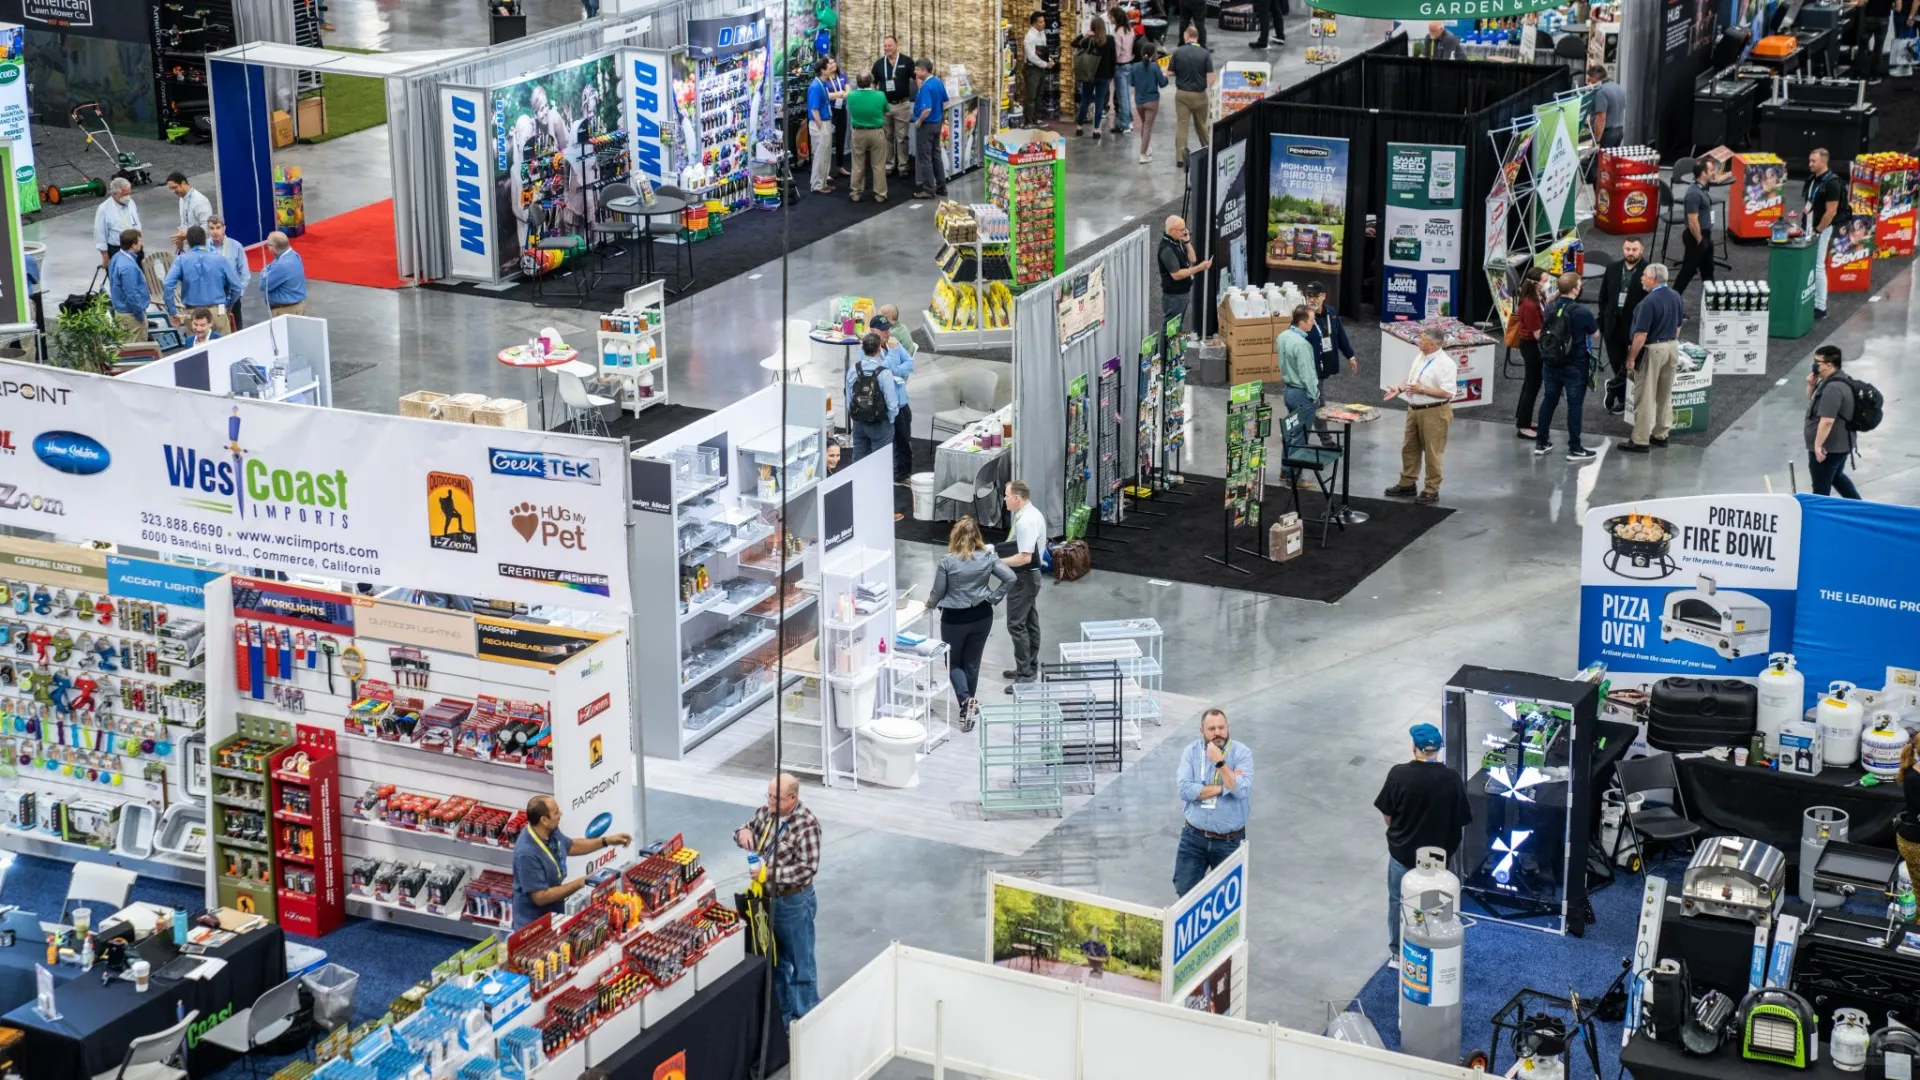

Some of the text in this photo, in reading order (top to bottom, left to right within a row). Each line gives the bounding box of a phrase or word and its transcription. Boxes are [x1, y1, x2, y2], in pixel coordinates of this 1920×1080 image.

[30, 6, 86, 20] Lawn Mower Co.
[1420, 2, 1504, 15] GARDEN
[1513, 0, 1523, 10] &
[10, 122, 18, 130] THE
[12, 115, 26, 123] ENJOY
[4, 128, 24, 136] PERFECT
[496, 100, 508, 170] DRAMM
[1289, 148, 1328, 156] PENNINGTON
[1393, 156, 1426, 164] SMART
[1281, 162, 1336, 174] HIGH-QUALITY
[1392, 162, 1426, 170] SEED
[452, 96, 486, 256] DRAMM
[1284, 170, 1332, 182] BIRD SEED
[1425, 228, 1454, 236] PATCH
[1388, 278, 1416, 286] LAWN
[1388, 286, 1417, 294] BOOSTER
[0, 380, 72, 405] POINT
[1672, 397, 1706, 406] ARANTEED.
[44, 441, 68, 454] Home
[246, 458, 348, 510] Coast
[430, 474, 470, 494] OUTDOORSMAN
[632, 500, 671, 510] esign Ideas
[254, 504, 349, 530] IMPORTS
[542, 505, 586, 524] HUG My
[1709, 506, 1778, 534] PORTABLE
[140, 512, 379, 560] 323.888.6690 www.wciimports.com
[463, 534, 472, 542] by
[542, 521, 587, 550] Pet
[1683, 526, 1776, 560] FIRE BOWL
[142, 530, 381, 576] 6000 Bandini Blvd., Commerce, California
[14, 556, 84, 574] CAMPING LIGHTS
[500, 565, 556, 580] CREATIVE
[1749, 565, 1774, 573] campfire
[120, 575, 205, 594] ACCENT LIGHTIN
[262, 598, 325, 616] WORKLIGHTS
[1602, 593, 1650, 622] PIZZA
[1820, 589, 1842, 602] THE
[1845, 591, 1897, 609] LEADING
[368, 618, 462, 639] OUTDOOR LIGHTING
[478, 623, 518, 636] FARPOINT
[1601, 619, 1645, 649] OVEN
[482, 638, 554, 653] RECHARGEABLES
[1602, 649, 1621, 657] Artisan
[1701, 662, 1717, 670] home
[578, 698, 608, 724] i-Zoom
[572, 772, 621, 810] FARPOINT
[284, 911, 312, 923] i-Zoom
[1175, 874, 1240, 958] MISCO
[1175, 920, 1238, 984] home and garden
